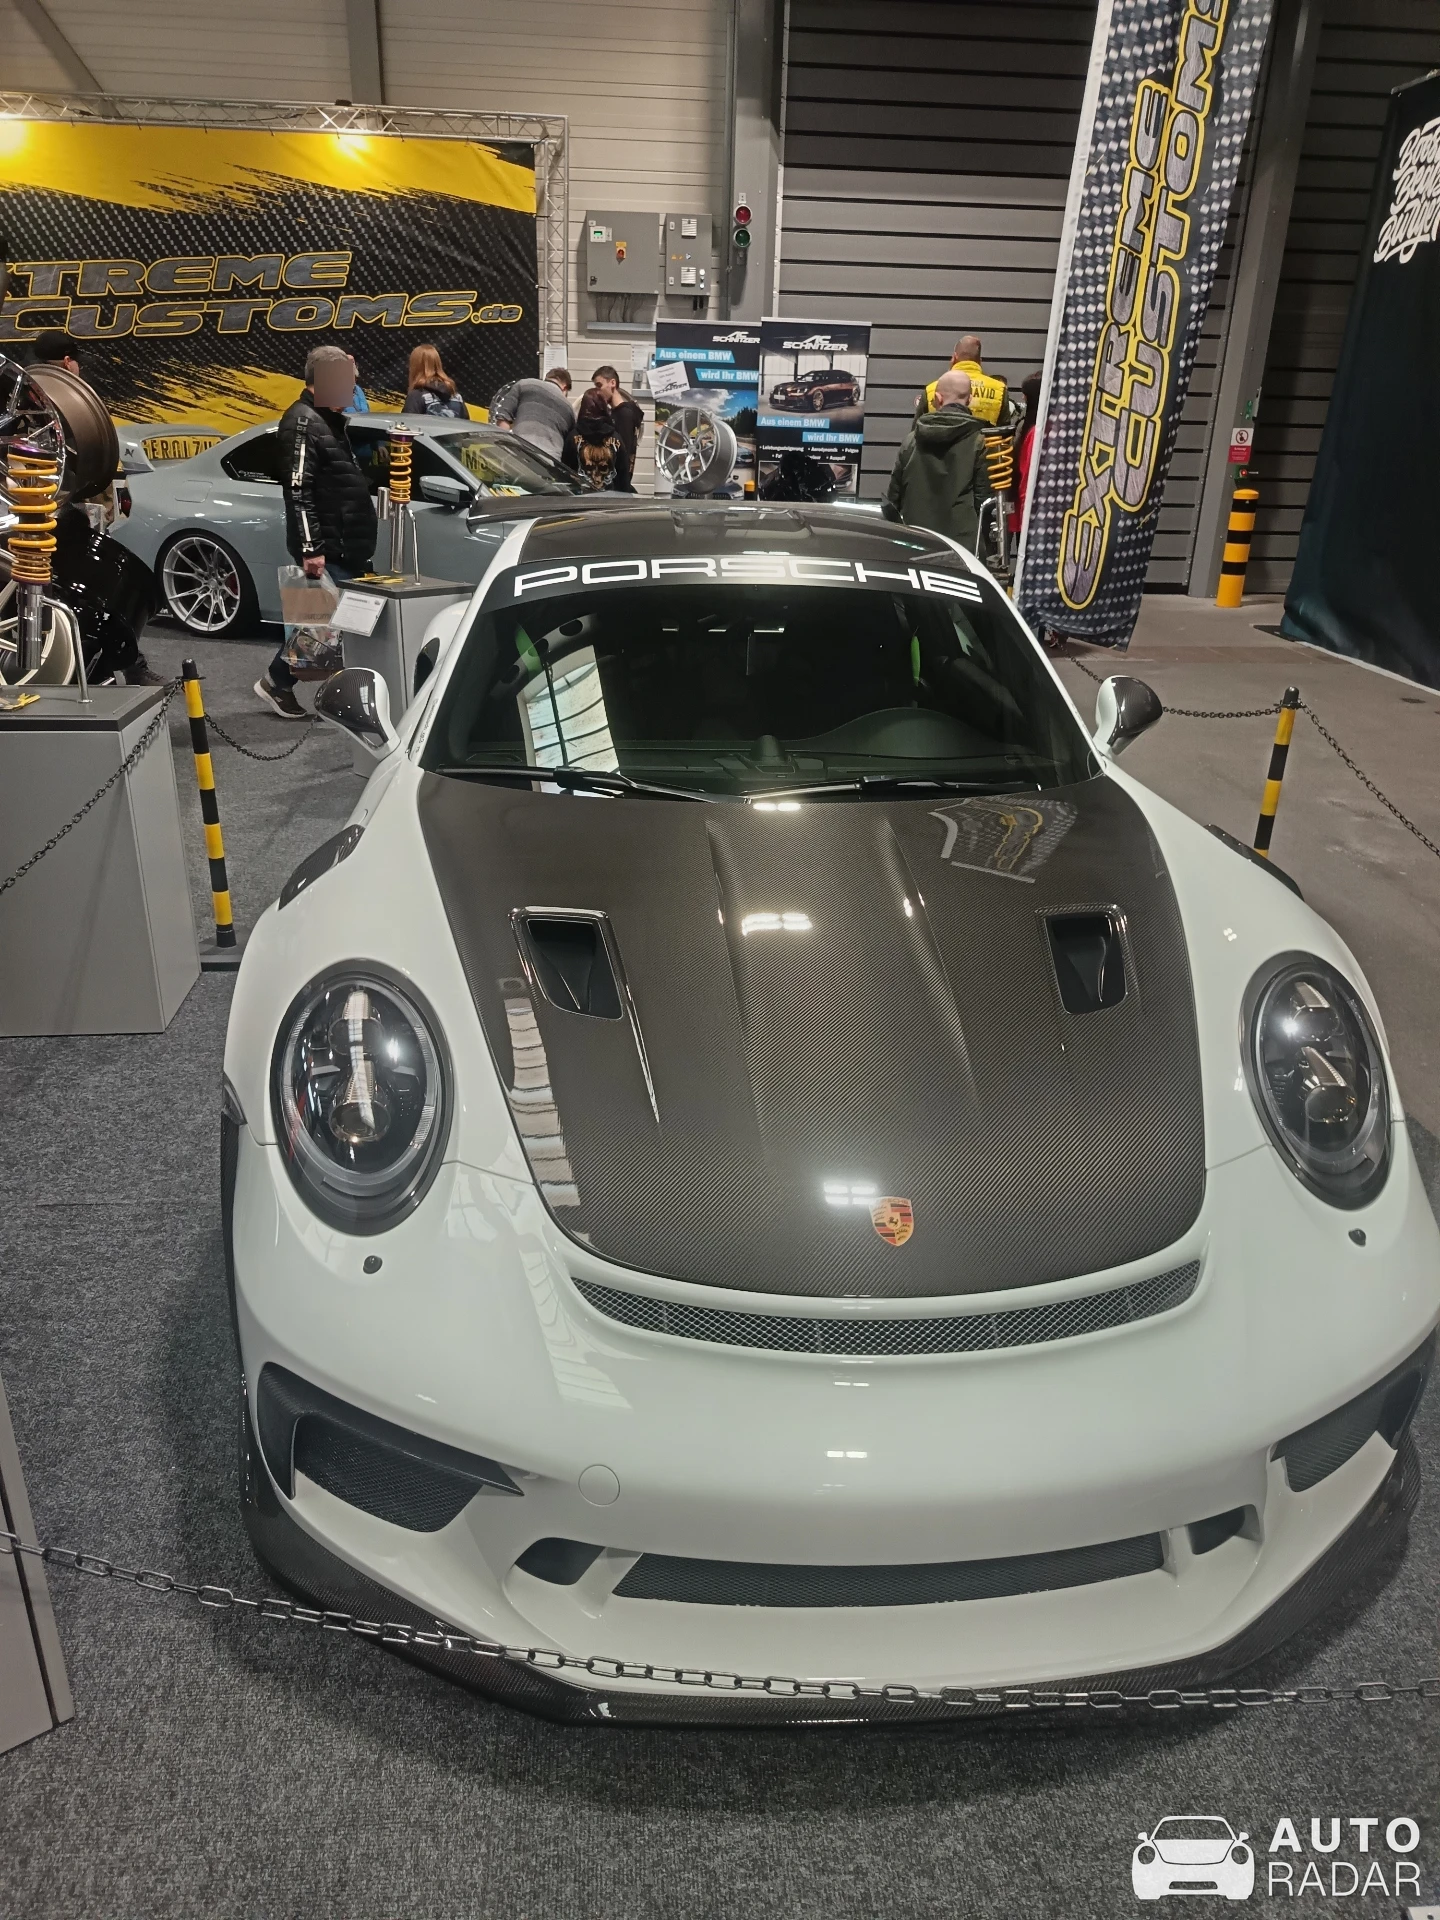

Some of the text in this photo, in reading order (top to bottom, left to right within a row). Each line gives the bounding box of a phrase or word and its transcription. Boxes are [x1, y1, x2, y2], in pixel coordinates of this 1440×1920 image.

[1112, 0, 1229, 512] CUSTOM
[5, 251, 352, 299] TREME
[712, 335, 760, 343] SCHNITZER
[1056, 79, 1171, 610] EXTREME
[782, 341, 848, 351] SCHNITZER
[660, 349, 731, 360] Aus einem BMW
[701, 370, 759, 381] wird Ihr BMW
[970, 387, 996, 399] AVID
[761, 417, 826, 427] Aus einem BMW
[807, 434, 860, 443] wird Ihr BMW
[513, 557, 983, 603] PORSCHE
